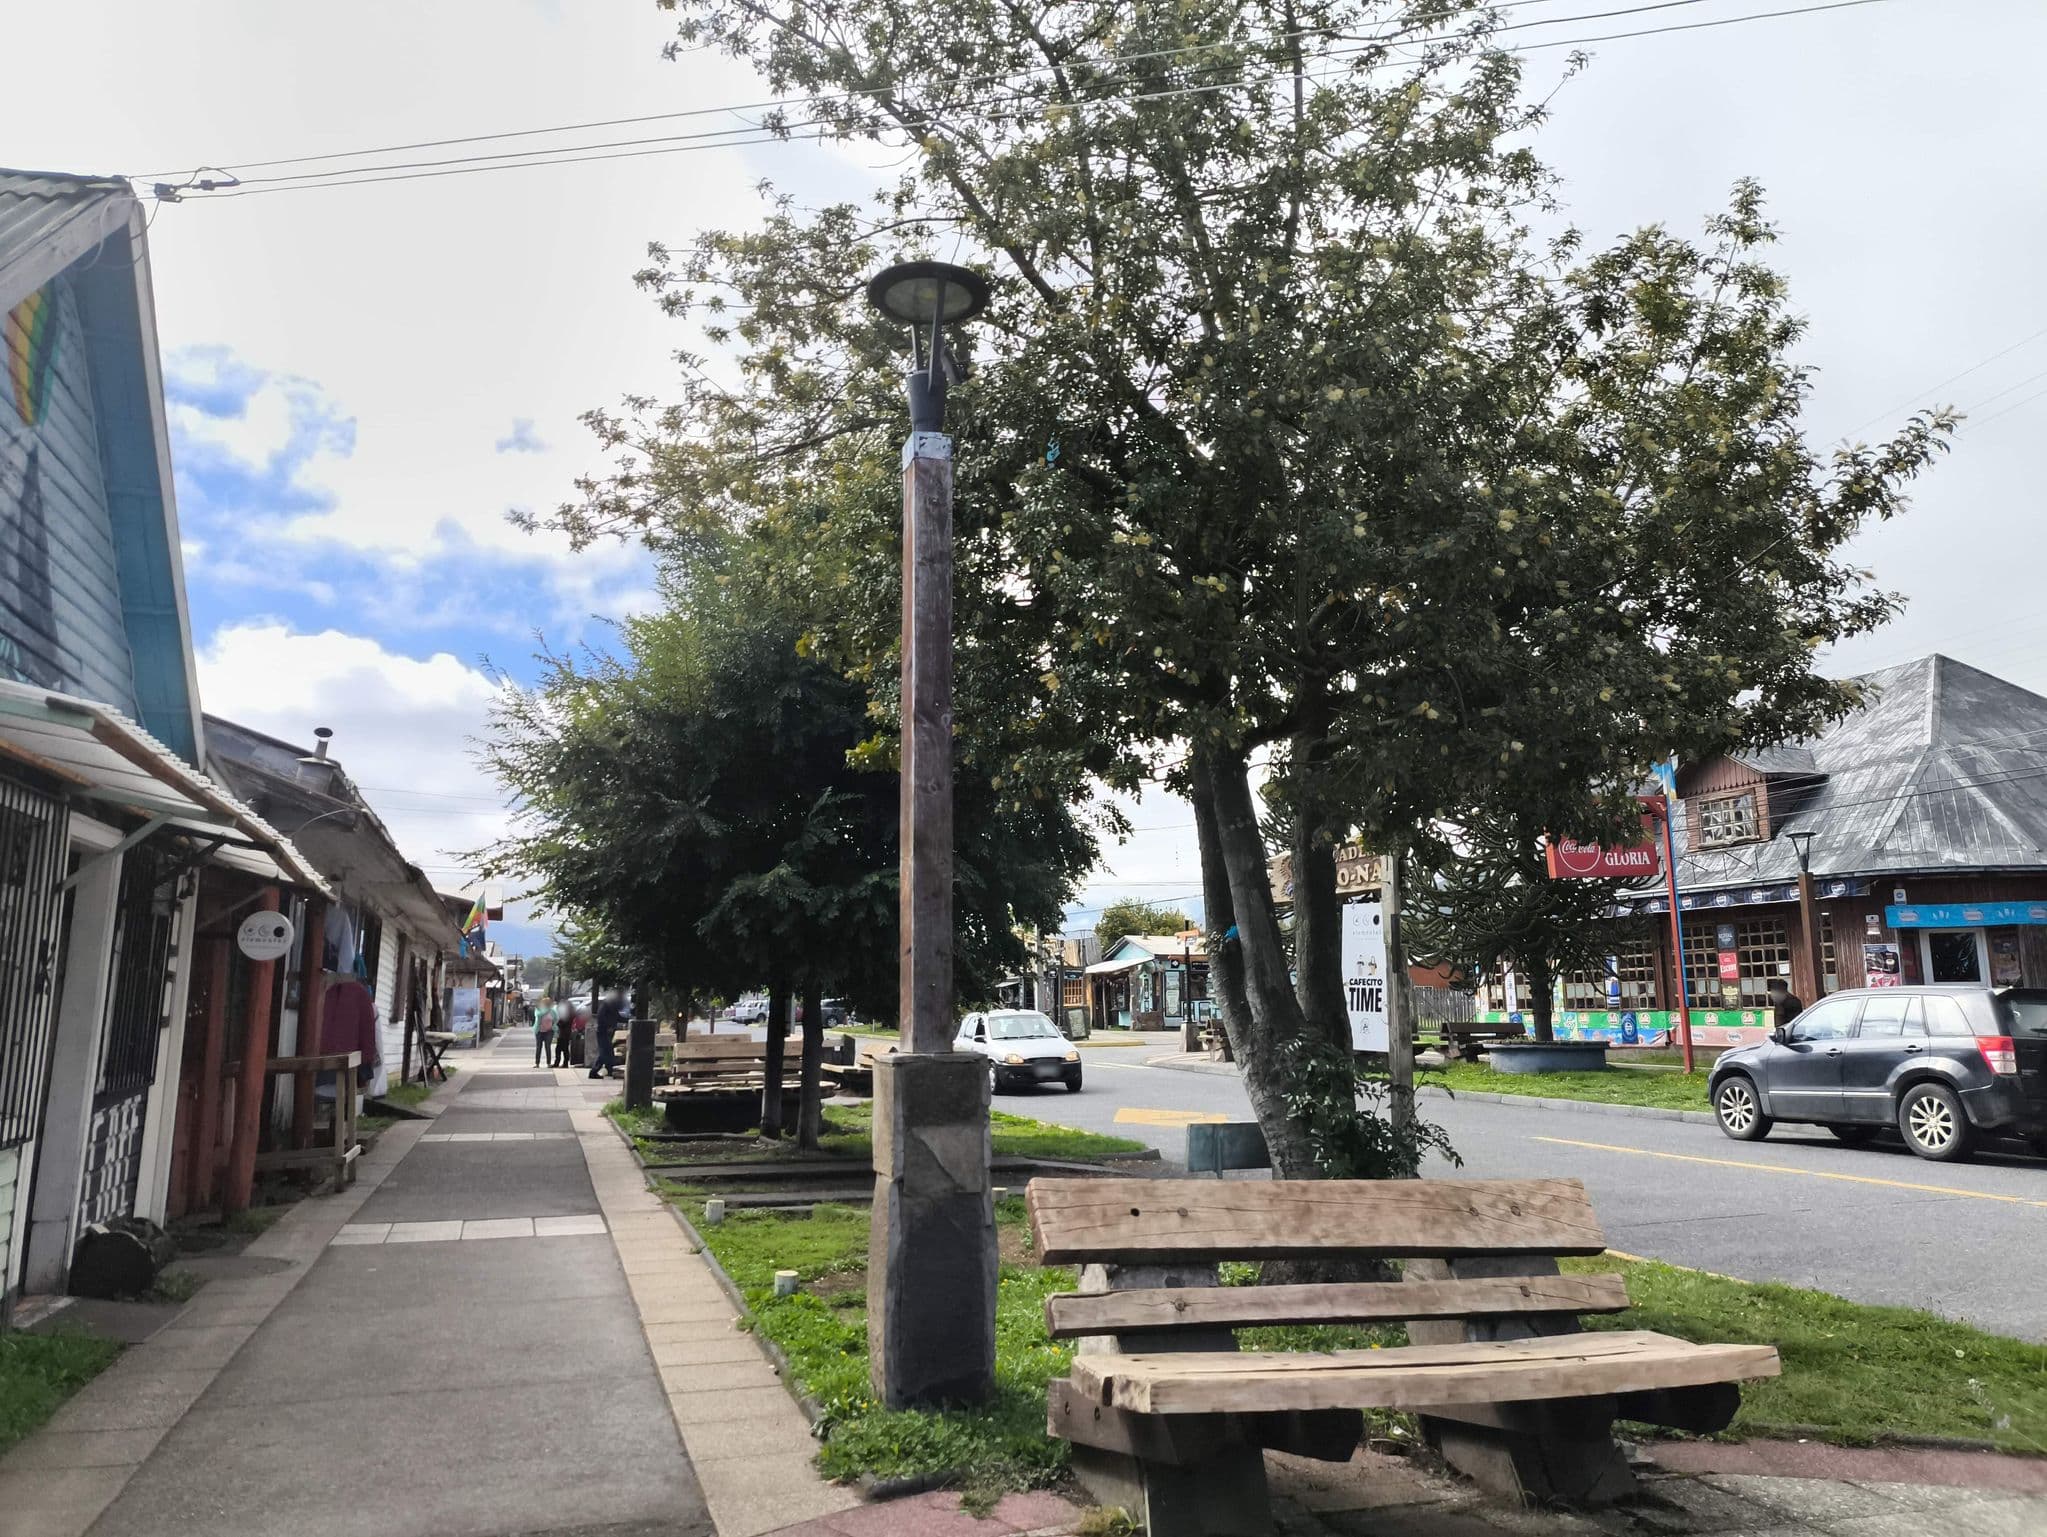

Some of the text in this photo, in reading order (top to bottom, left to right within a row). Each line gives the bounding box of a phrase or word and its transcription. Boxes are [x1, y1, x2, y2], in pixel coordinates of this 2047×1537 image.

[1605, 851, 1651, 866] GLORIA
[1349, 978, 1383, 986] CAFECITO
[1349, 987, 1382, 1012] TIME
